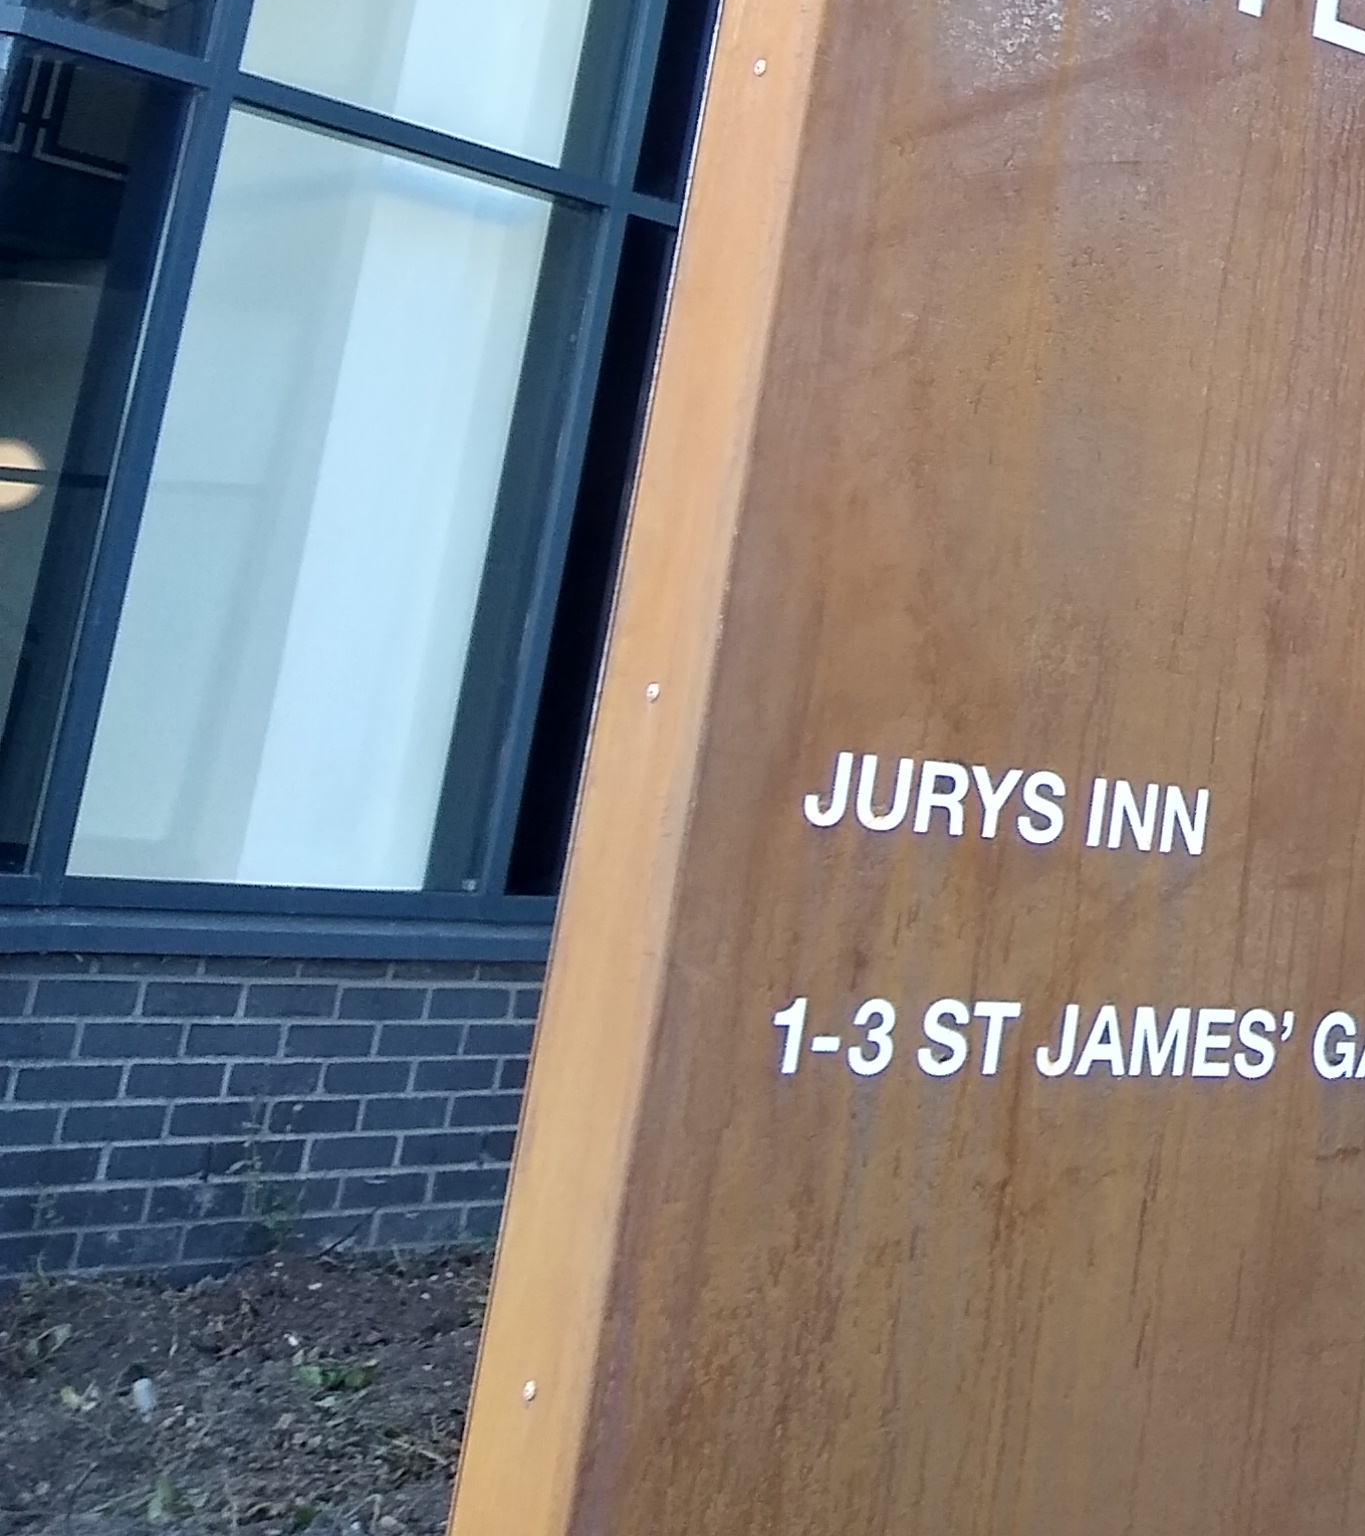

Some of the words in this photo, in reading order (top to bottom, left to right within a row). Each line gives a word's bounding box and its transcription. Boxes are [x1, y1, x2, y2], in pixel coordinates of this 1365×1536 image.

[803, 751, 1067, 844] JURYS
[1085, 777, 1210, 856] INN
[772, 997, 897, 1076] 1-3
[916, 998, 1022, 1077] ST
[1035, 1003, 1295, 1080] JAMES’
